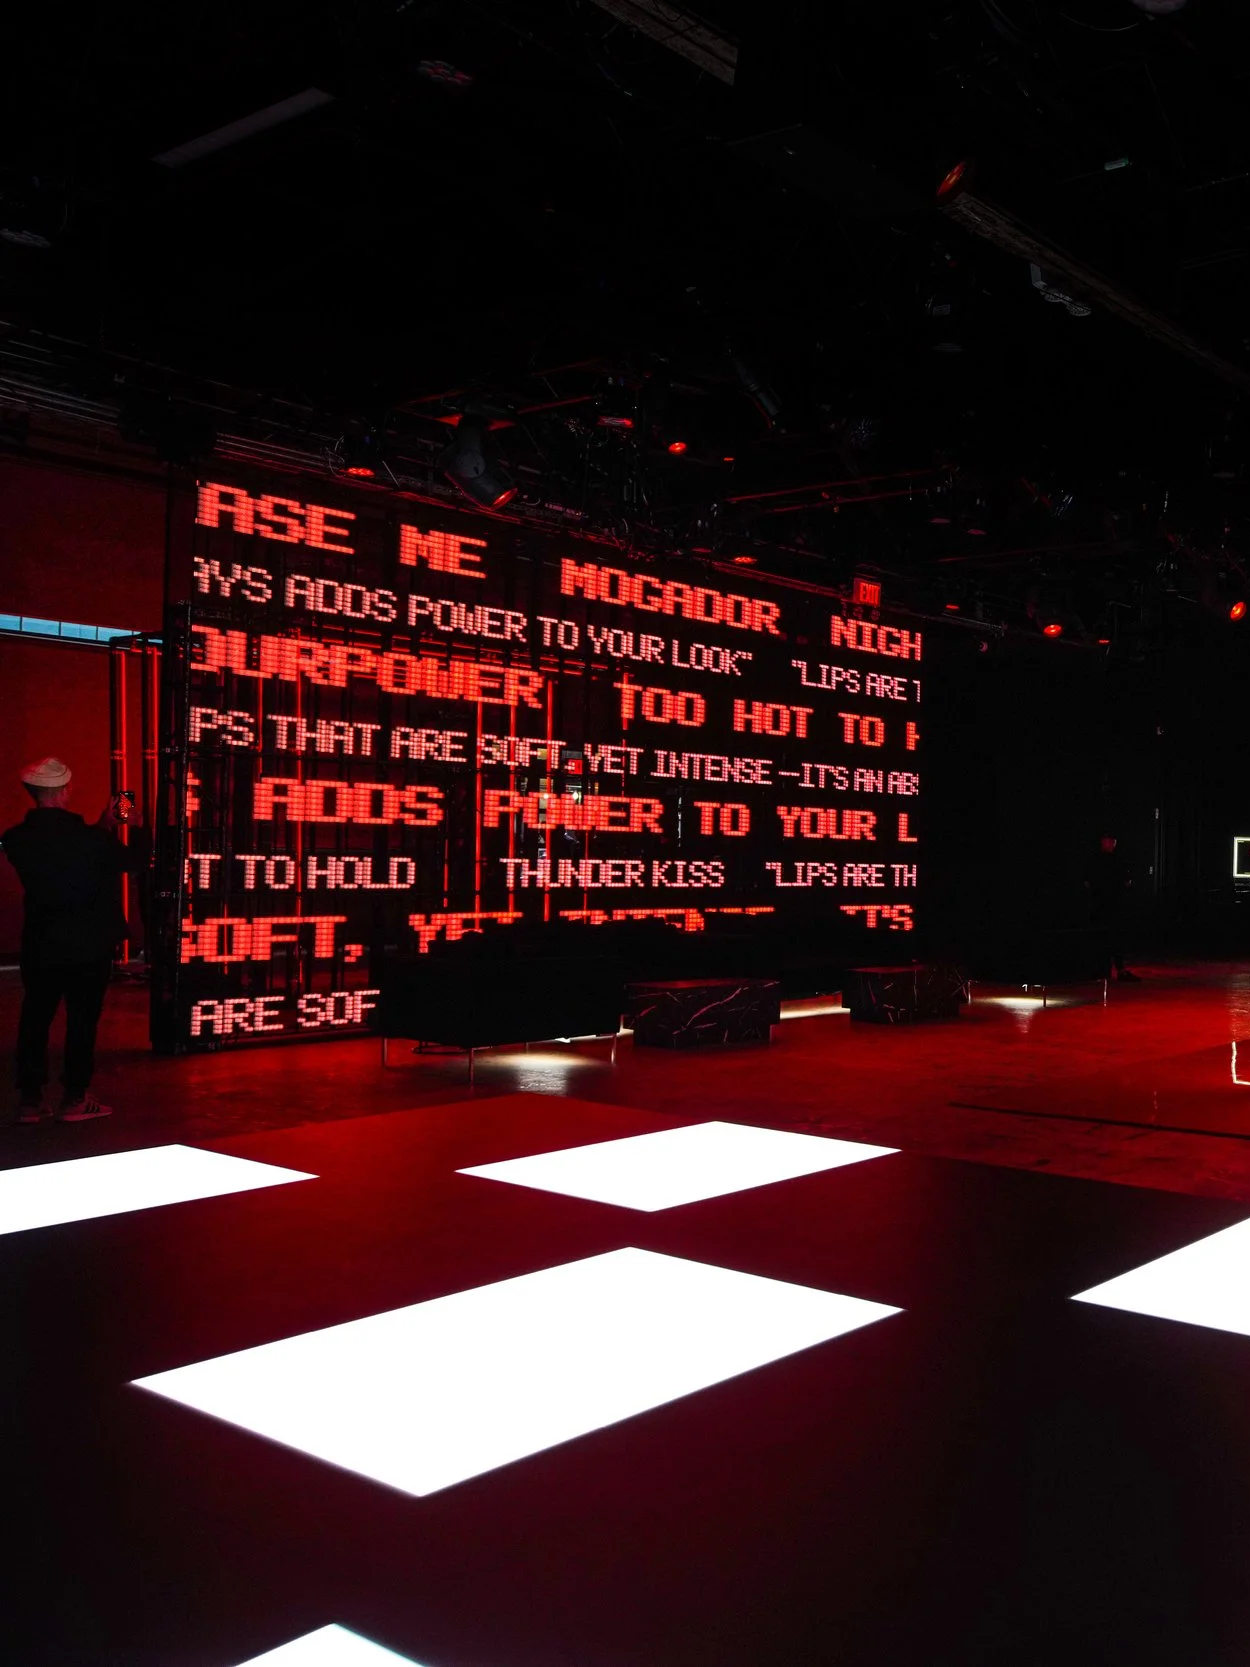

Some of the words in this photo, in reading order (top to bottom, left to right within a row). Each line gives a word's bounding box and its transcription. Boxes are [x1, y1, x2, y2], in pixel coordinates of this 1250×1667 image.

[197, 480, 355, 553] ASE
[400, 524, 487, 579] ME
[561, 558, 781, 635] MOGADOR
[831, 615, 920, 660] NIGH
[284, 575, 397, 622] ADDS
[408, 594, 527, 642] POWER
[537, 615, 579, 651] TO
[587, 625, 665, 664] YOUR
[672, 639, 752, 676] LOOK"
[866, 672, 908, 701] ARE
[613, 681, 705, 727] TOO
[734, 699, 814, 738] HOT
[838, 712, 884, 747] TO
[189, 706, 254, 746] PS
[267, 714, 381, 756] THAT
[391, 727, 467, 762] ARE
[584, 743, 644, 775] YET
[650, 749, 773, 784] INTENSE
[854, 768, 883, 793] AN
[887, 771, 919, 795] AB
[253, 777, 444, 826] ADDS
[483, 790, 665, 833] POWER
[694, 801, 750, 837] TO
[777, 806, 877, 841] YOUR
[235, 855, 295, 889] TO
[307, 856, 415, 889] HOLD
[500, 858, 645, 888] THUNDER
[652, 860, 725, 888] KISS
[843, 863, 885, 887] ARE
[890, 864, 917, 887] TH
[191, 996, 285, 1036] ARE
